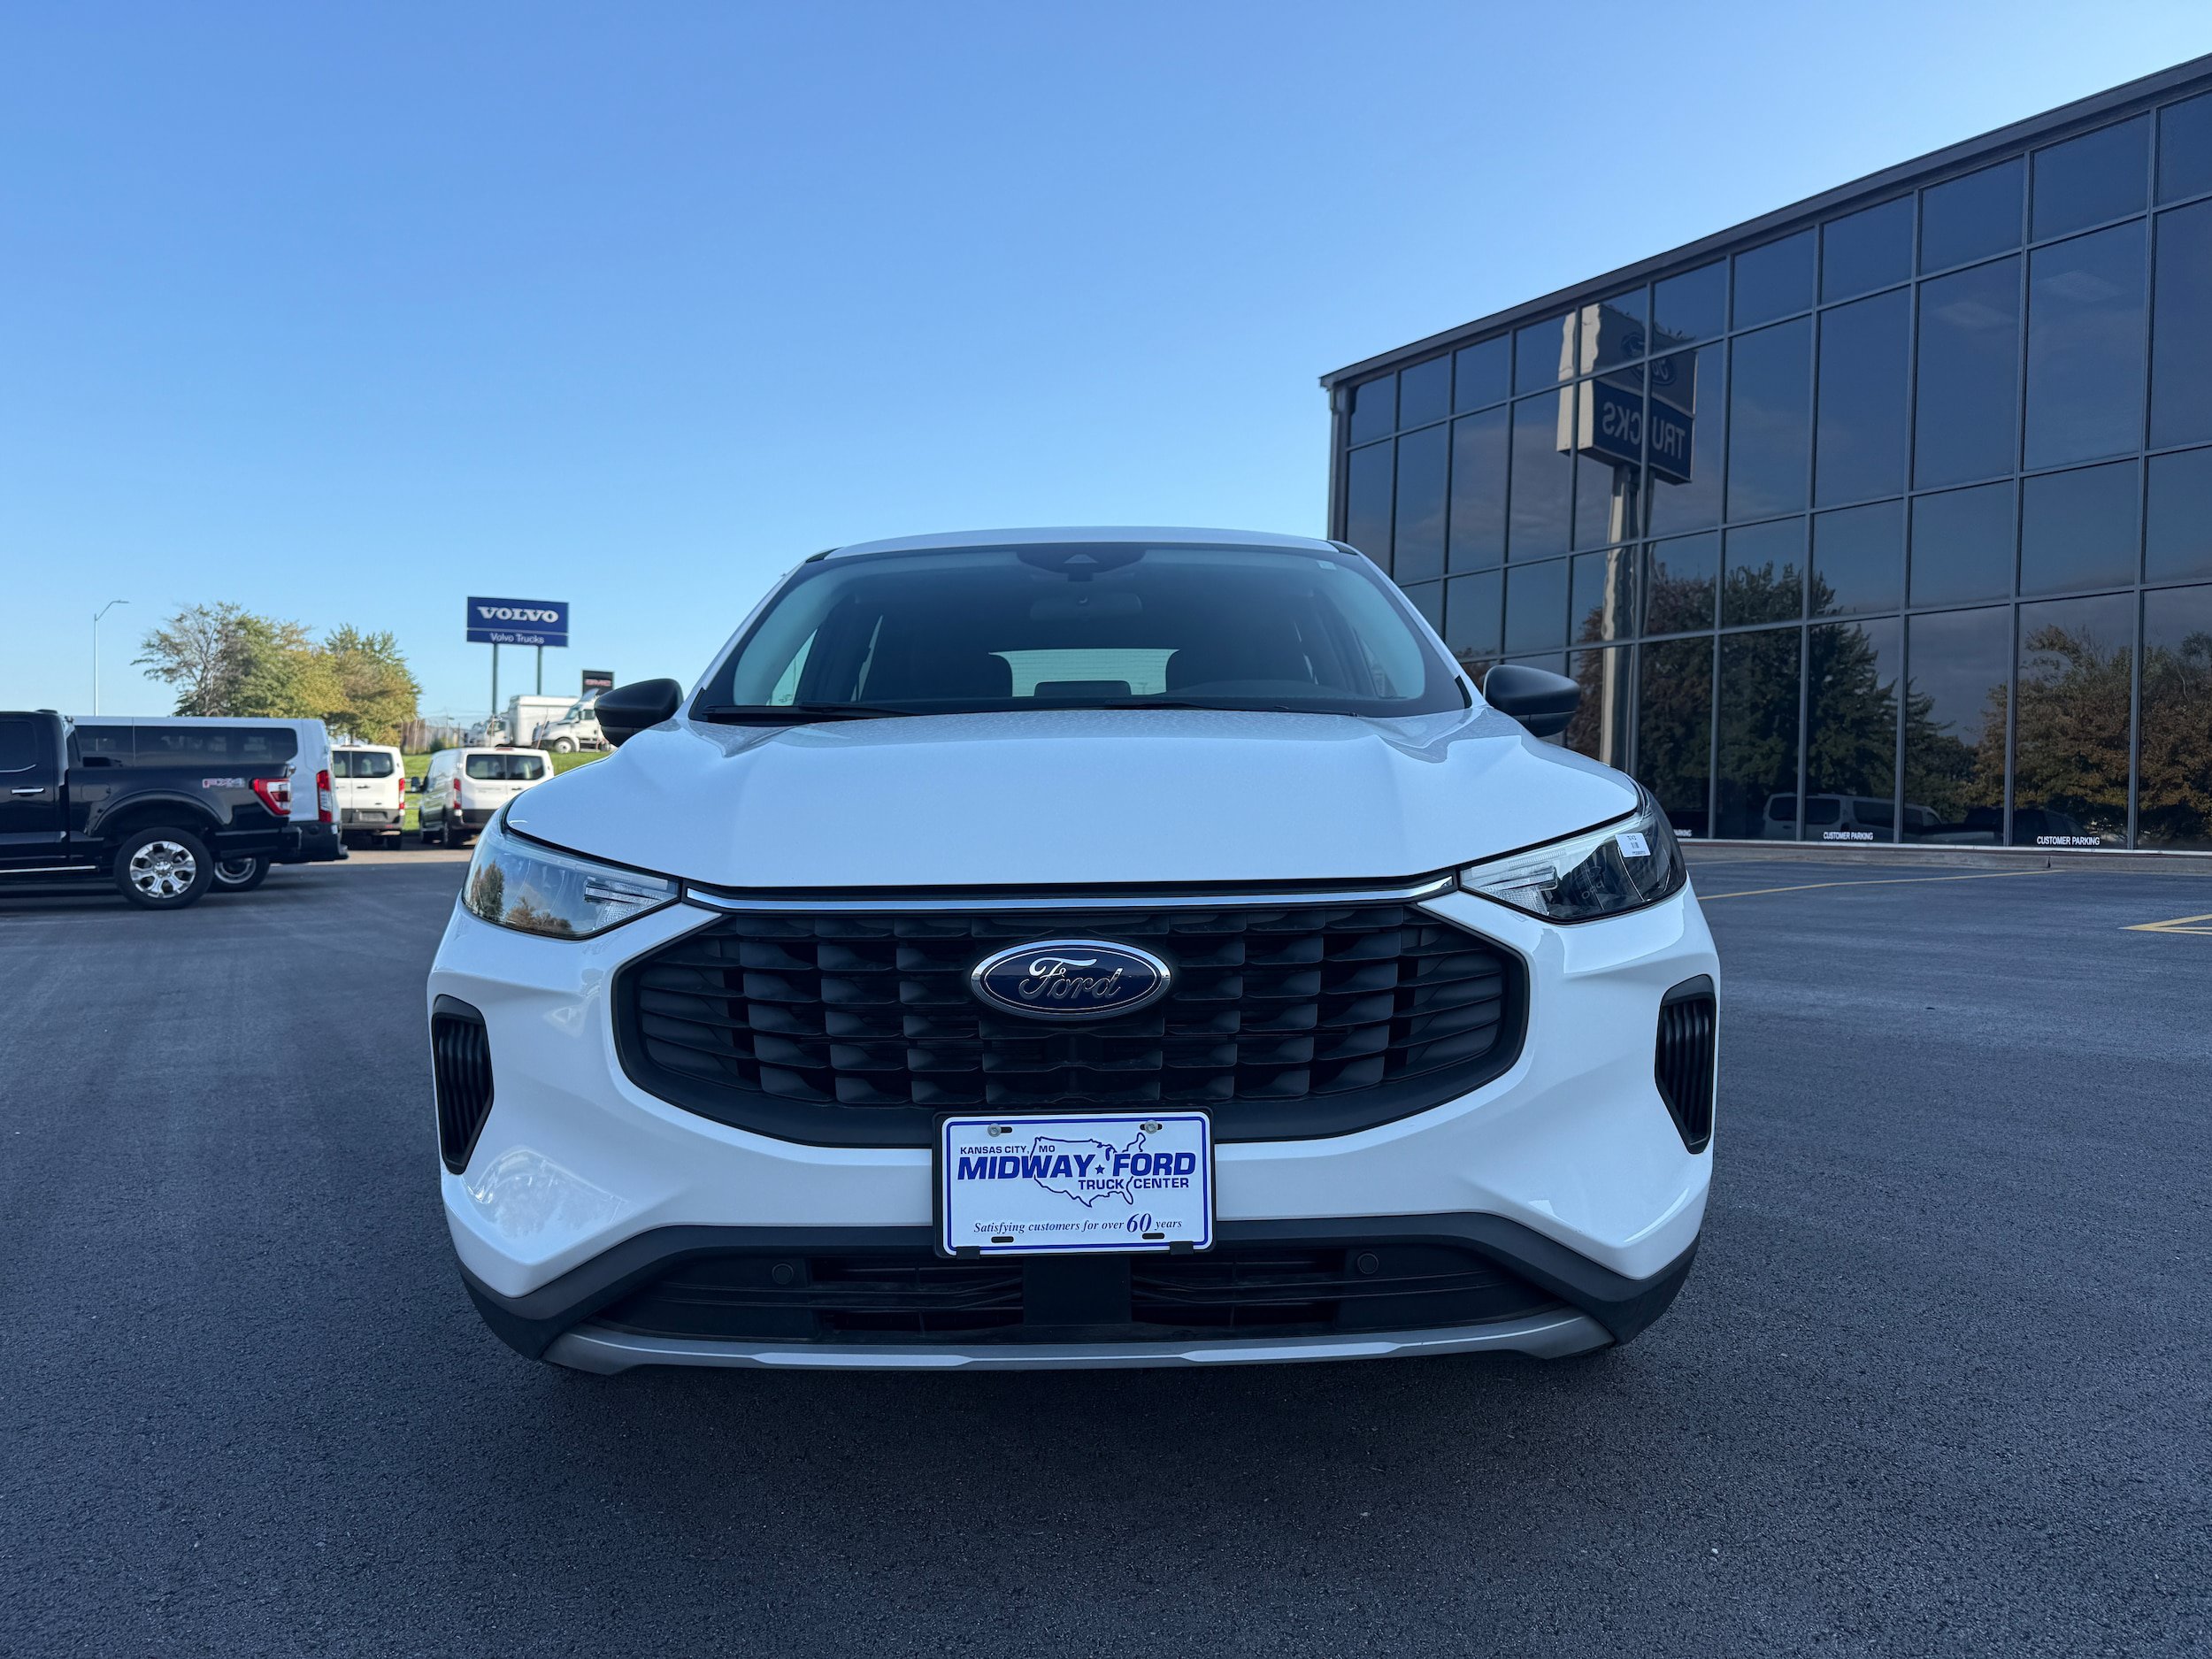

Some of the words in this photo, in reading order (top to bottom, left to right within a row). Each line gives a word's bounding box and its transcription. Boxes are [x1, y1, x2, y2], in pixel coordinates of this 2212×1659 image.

[477, 605, 559, 623] VOLVO
[489, 632, 514, 642] Volvo
[517, 634, 545, 644] Trucks
[1823, 831, 1850, 840] CUSTOMER
[1850, 832, 1874, 841] PARKING
[2036, 835, 2070, 845] CUSTOMER
[2071, 836, 2101, 846] PARKING
[1018, 956, 1124, 1000] Ford
[960, 1146, 1002, 1155] KANSAS
[1004, 1145, 1030, 1154] CITY,
[957, 1154, 1096, 1180] MIDWAY
[1112, 1152, 1196, 1177] FORD
[1078, 1179, 1125, 1190] TRUCK
[1133, 1177, 1189, 1189] CENTER
[973, 1221, 1025, 1234] Satisfying
[1028, 1221, 1082, 1232] customers
[1081, 1220, 1099, 1233] for
[1102, 1221, 1125, 1230] over
[1126, 1212, 1152, 1233] 60
[1154, 1219, 1183, 1231] years
